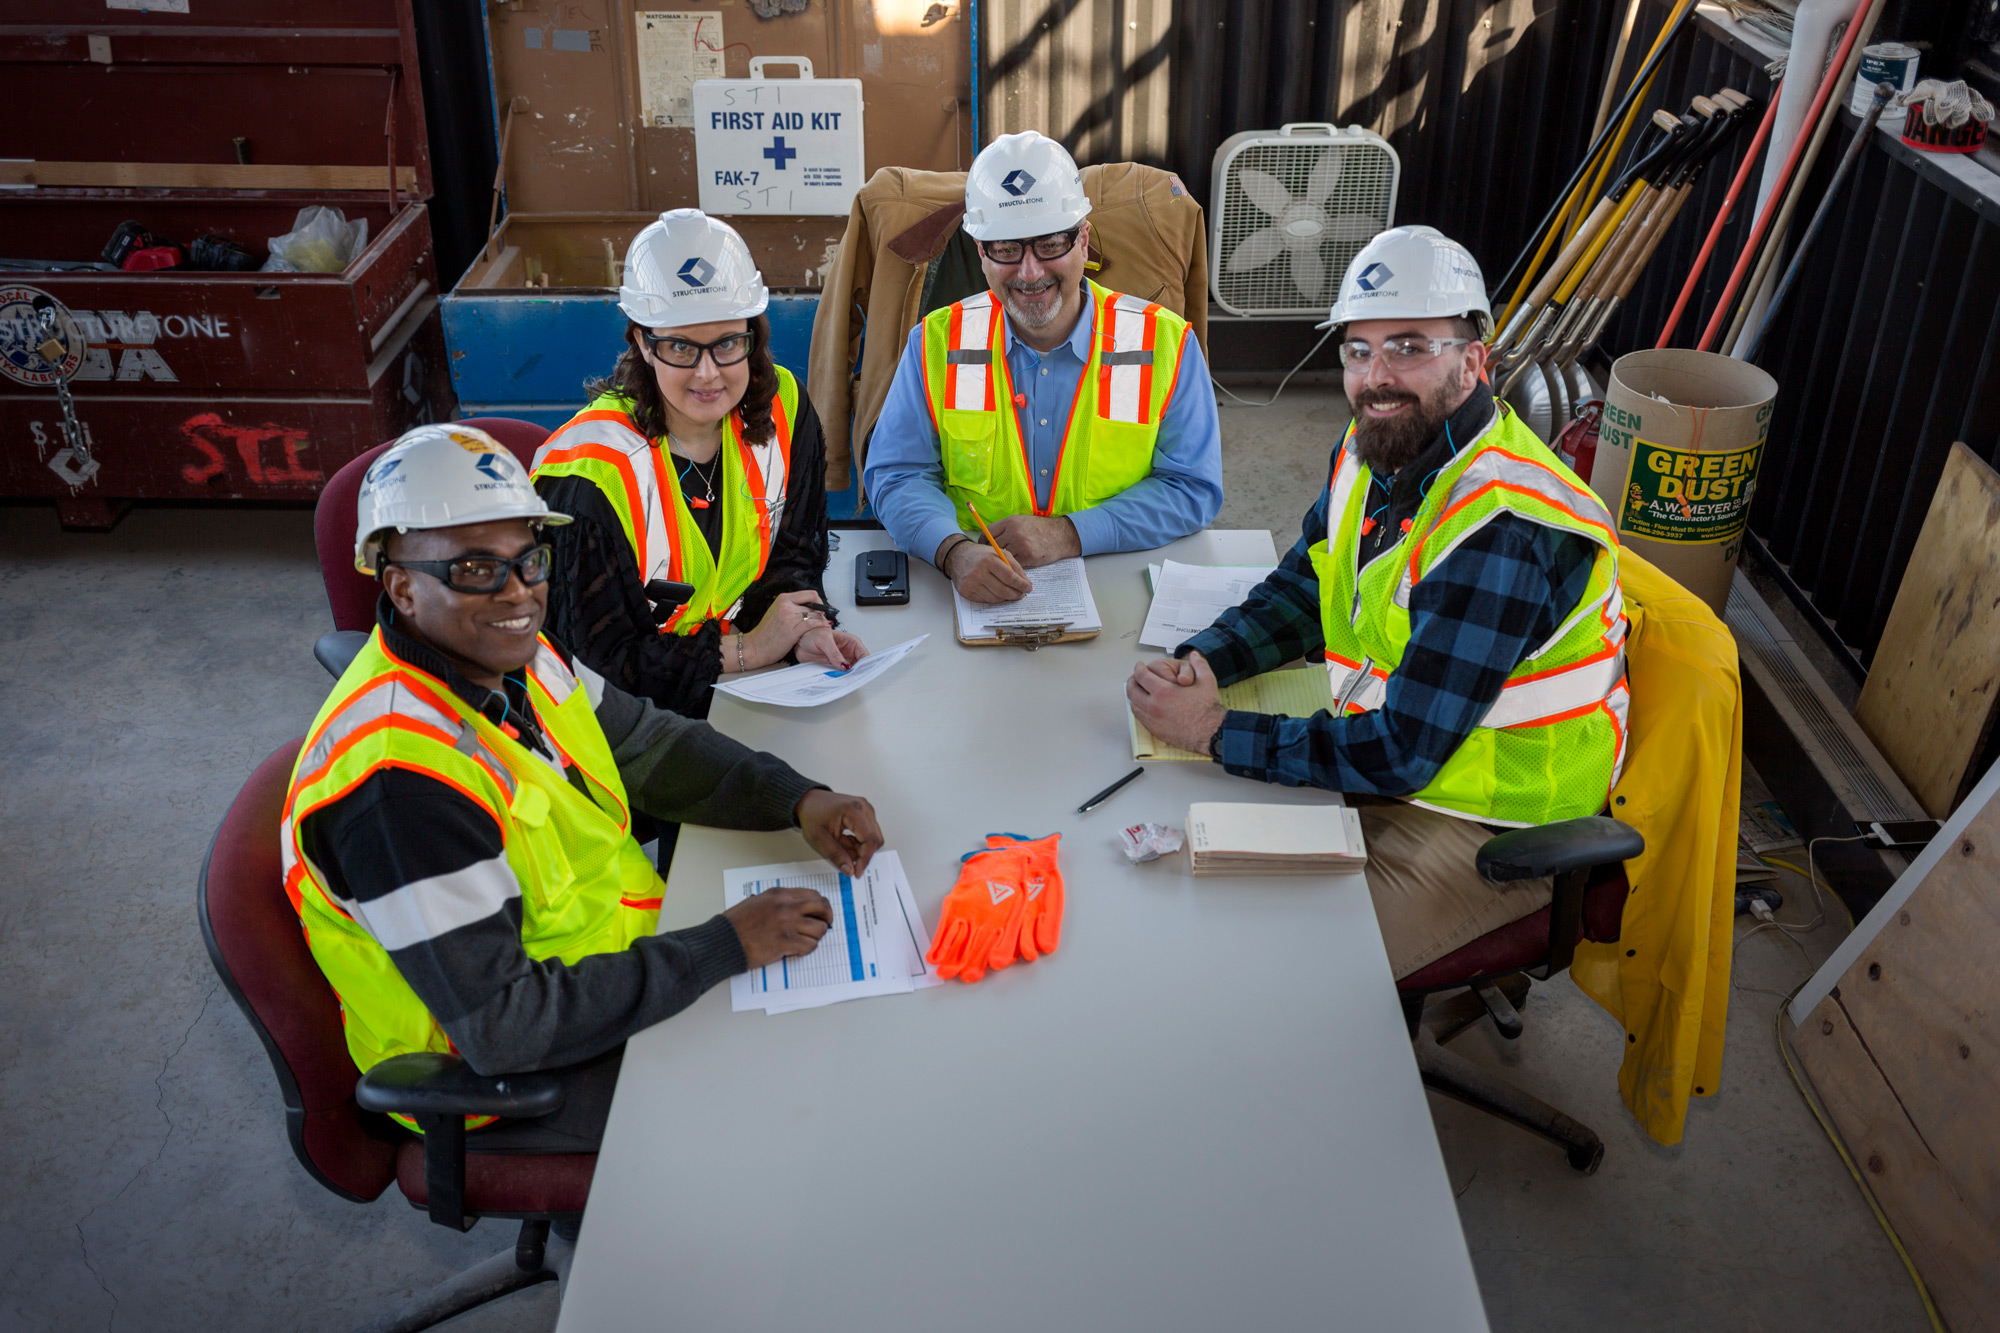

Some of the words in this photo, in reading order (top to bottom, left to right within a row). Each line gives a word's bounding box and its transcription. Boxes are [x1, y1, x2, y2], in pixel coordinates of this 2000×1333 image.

[1866, 58, 1886, 66] IPEX
[711, 112, 765, 130] FIRST
[772, 112, 804, 130] AID
[811, 113, 842, 130] KIT
[715, 171, 760, 186] FAK-7
[672, 285, 728, 298] STRUCTURETONE
[1647, 449, 1758, 479] GREEN
[1658, 475, 1746, 501] DUST
[1686, 502, 1732, 515] MEYER
[1628, 516, 1650, 528] Caution
[1654, 523, 1669, 531] Floor
[1696, 526, 1714, 534] Swept
